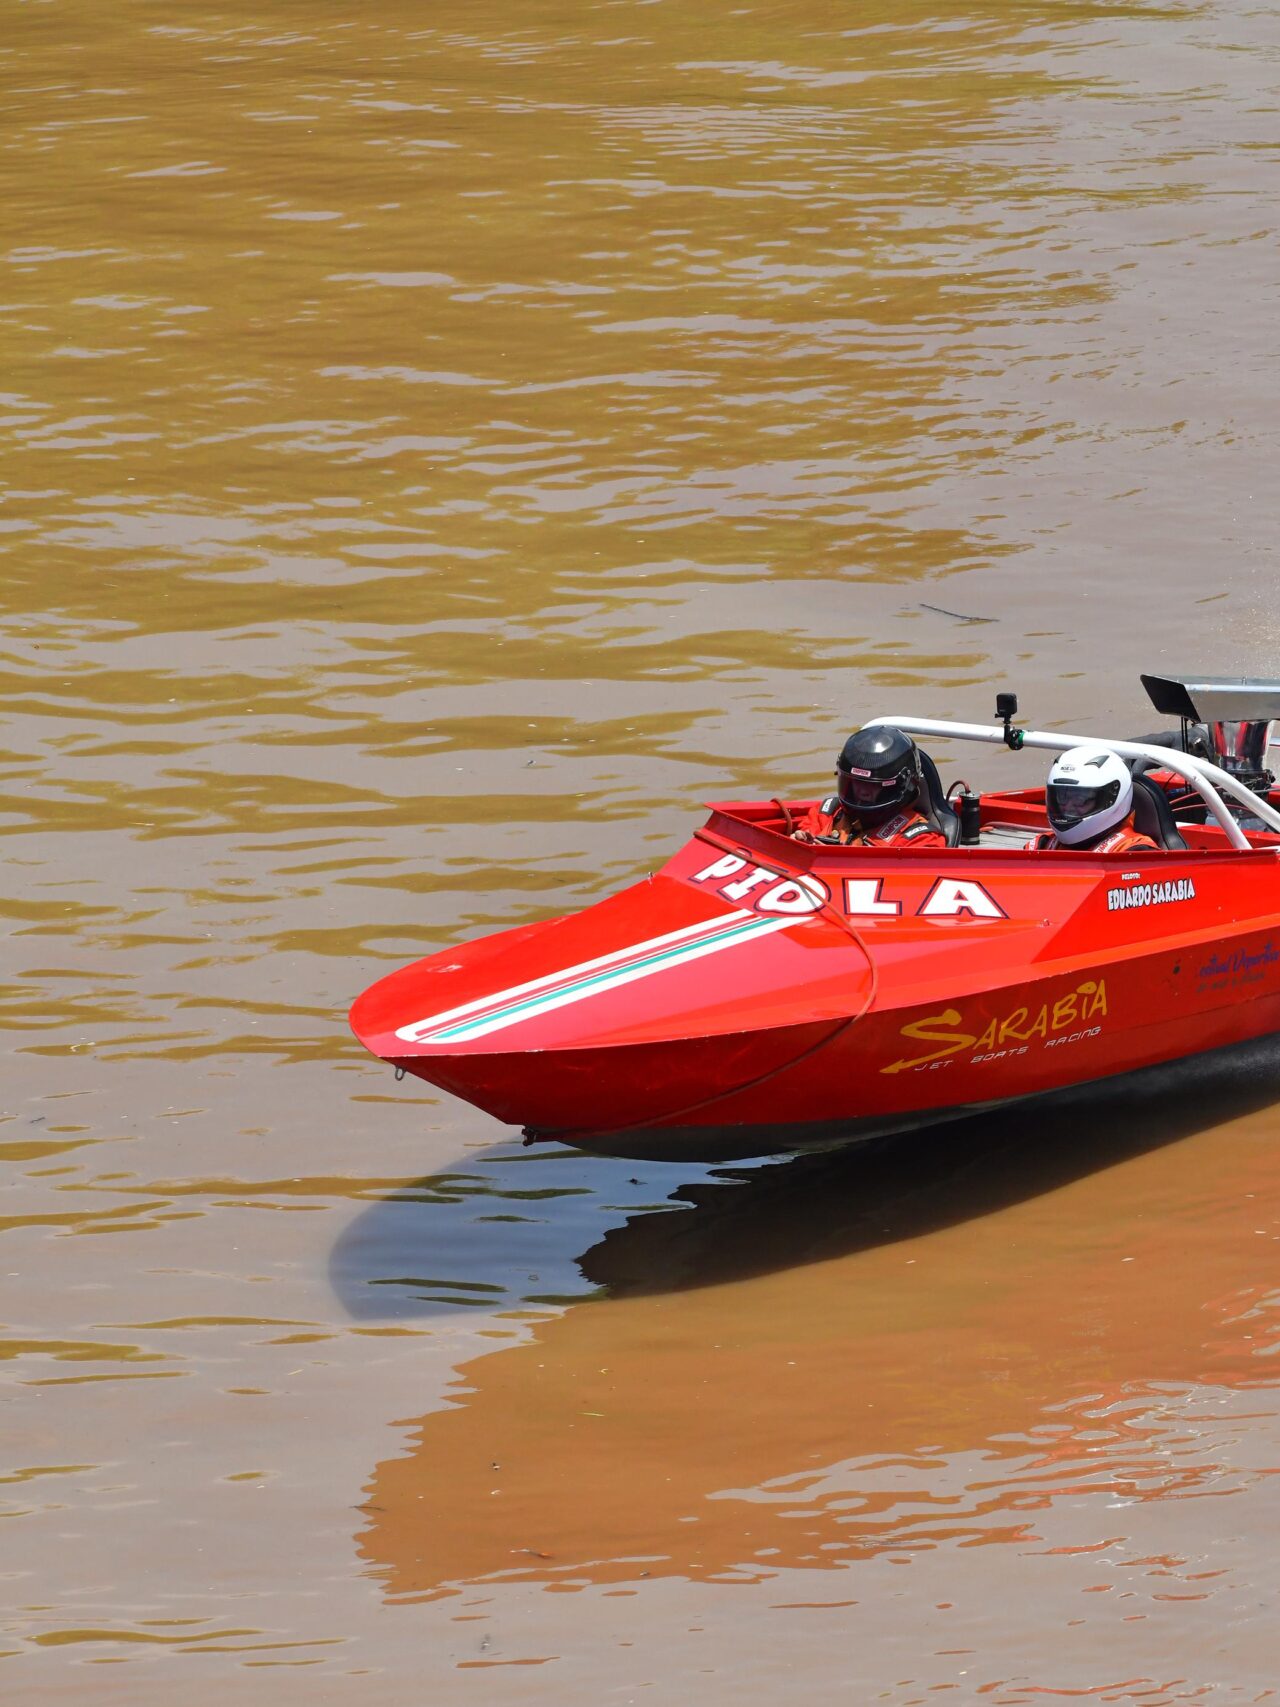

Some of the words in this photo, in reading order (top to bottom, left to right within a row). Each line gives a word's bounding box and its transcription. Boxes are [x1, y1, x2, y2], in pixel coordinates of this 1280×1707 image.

[688, 847, 1009, 919] PIOLA
[1107, 885, 1152, 911] EDUARDO
[1152, 878, 1195, 905] SARABIA
[914, 1059, 954, 1071] JET
[970, 1046, 1029, 1064] BOATS
[1044, 1026, 1101, 1049] RACING
